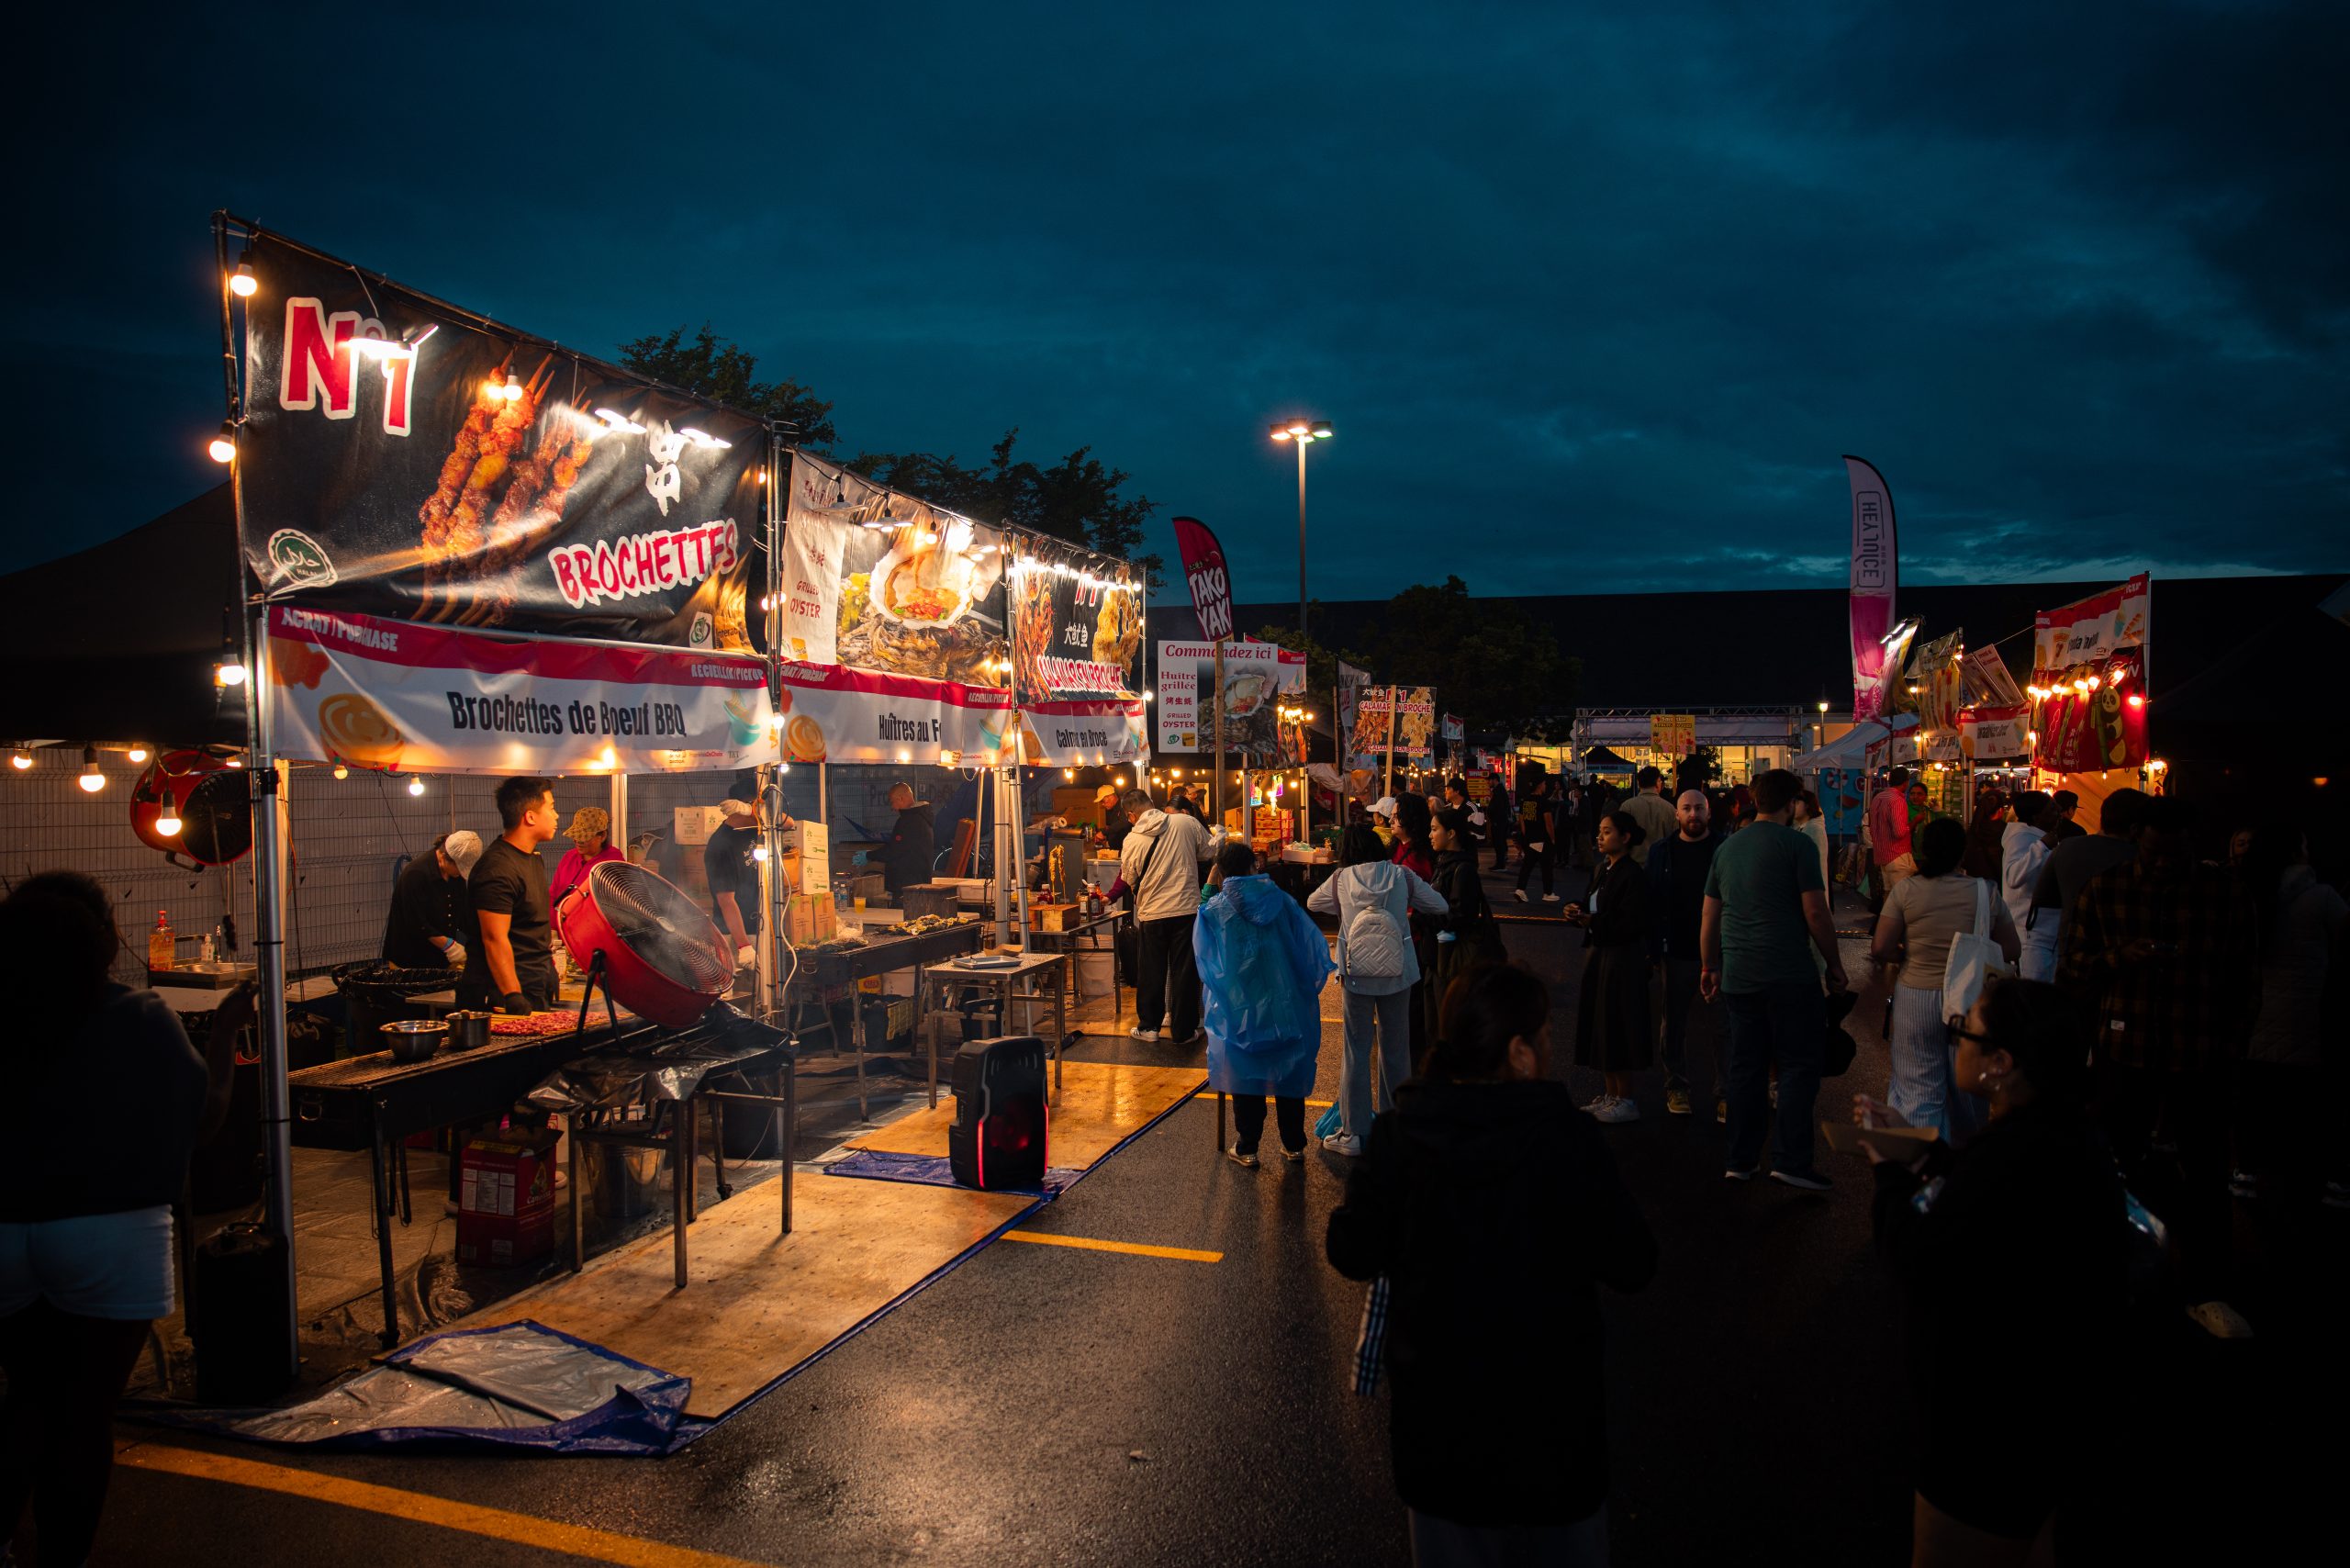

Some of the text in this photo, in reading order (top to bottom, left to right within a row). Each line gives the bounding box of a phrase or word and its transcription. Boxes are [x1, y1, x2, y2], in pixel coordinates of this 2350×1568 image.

[1861, 502, 1879, 577] HEY JUICE
[283, 546, 320, 566] حلال
[550, 519, 737, 608] BROCHETTES
[1189, 566, 1225, 610] TAKO
[790, 598, 821, 619] OYSTER
[1196, 597, 1232, 642] YAKI
[1255, 645, 1271, 659] ici
[1161, 671, 1196, 680] Huître
[1161, 680, 1196, 692] grillée
[1165, 697, 1192, 706] 烤生蚝
[1403, 702, 1432, 713] BROCHE
[446, 691, 687, 737] Brochettes de Boeuf BBQ
[878, 712, 915, 742] Huîtres
[917, 721, 930, 742] au
